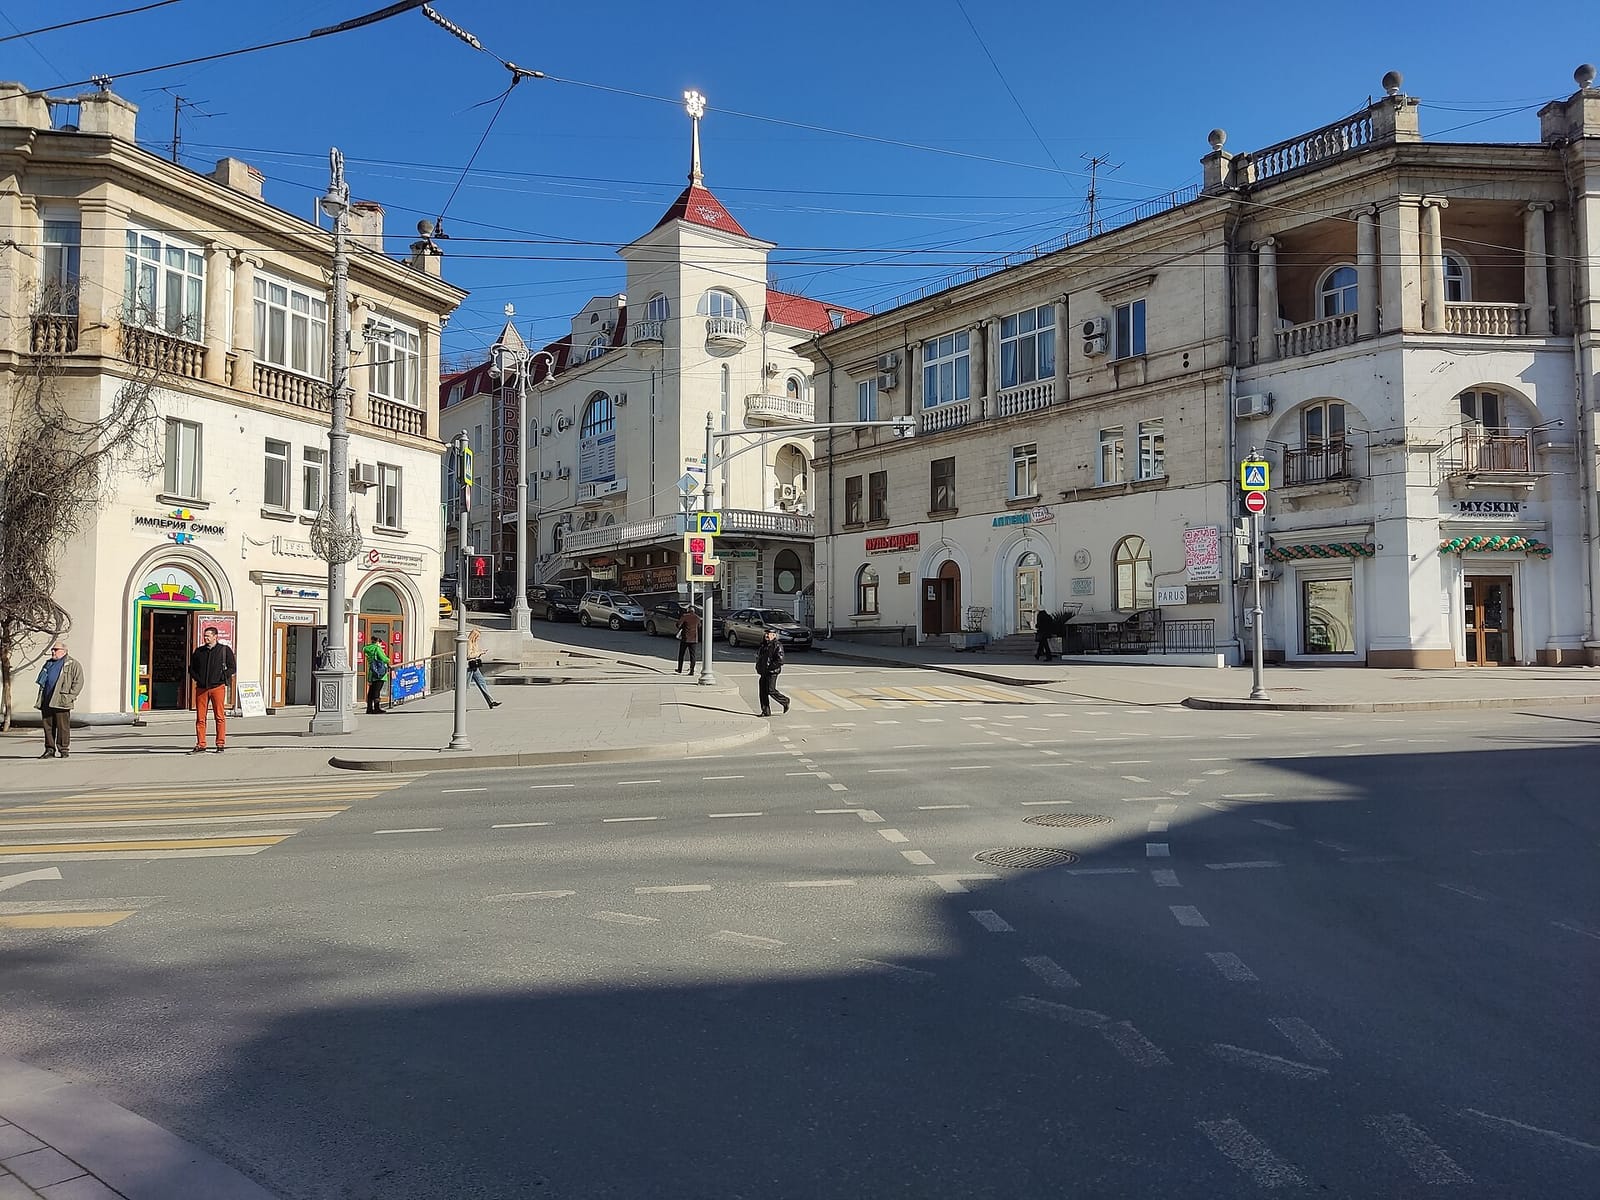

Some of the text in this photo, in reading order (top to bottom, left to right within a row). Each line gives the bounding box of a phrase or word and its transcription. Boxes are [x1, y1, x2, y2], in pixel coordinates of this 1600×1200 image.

[1460, 501, 1520, 512] MYSKIN
[134, 516, 225, 534] ИМПЕРИЯ СУМОК
[866, 533, 918, 550] МУЛЬТИДОМ
[1158, 590, 1185, 601] PARUS
